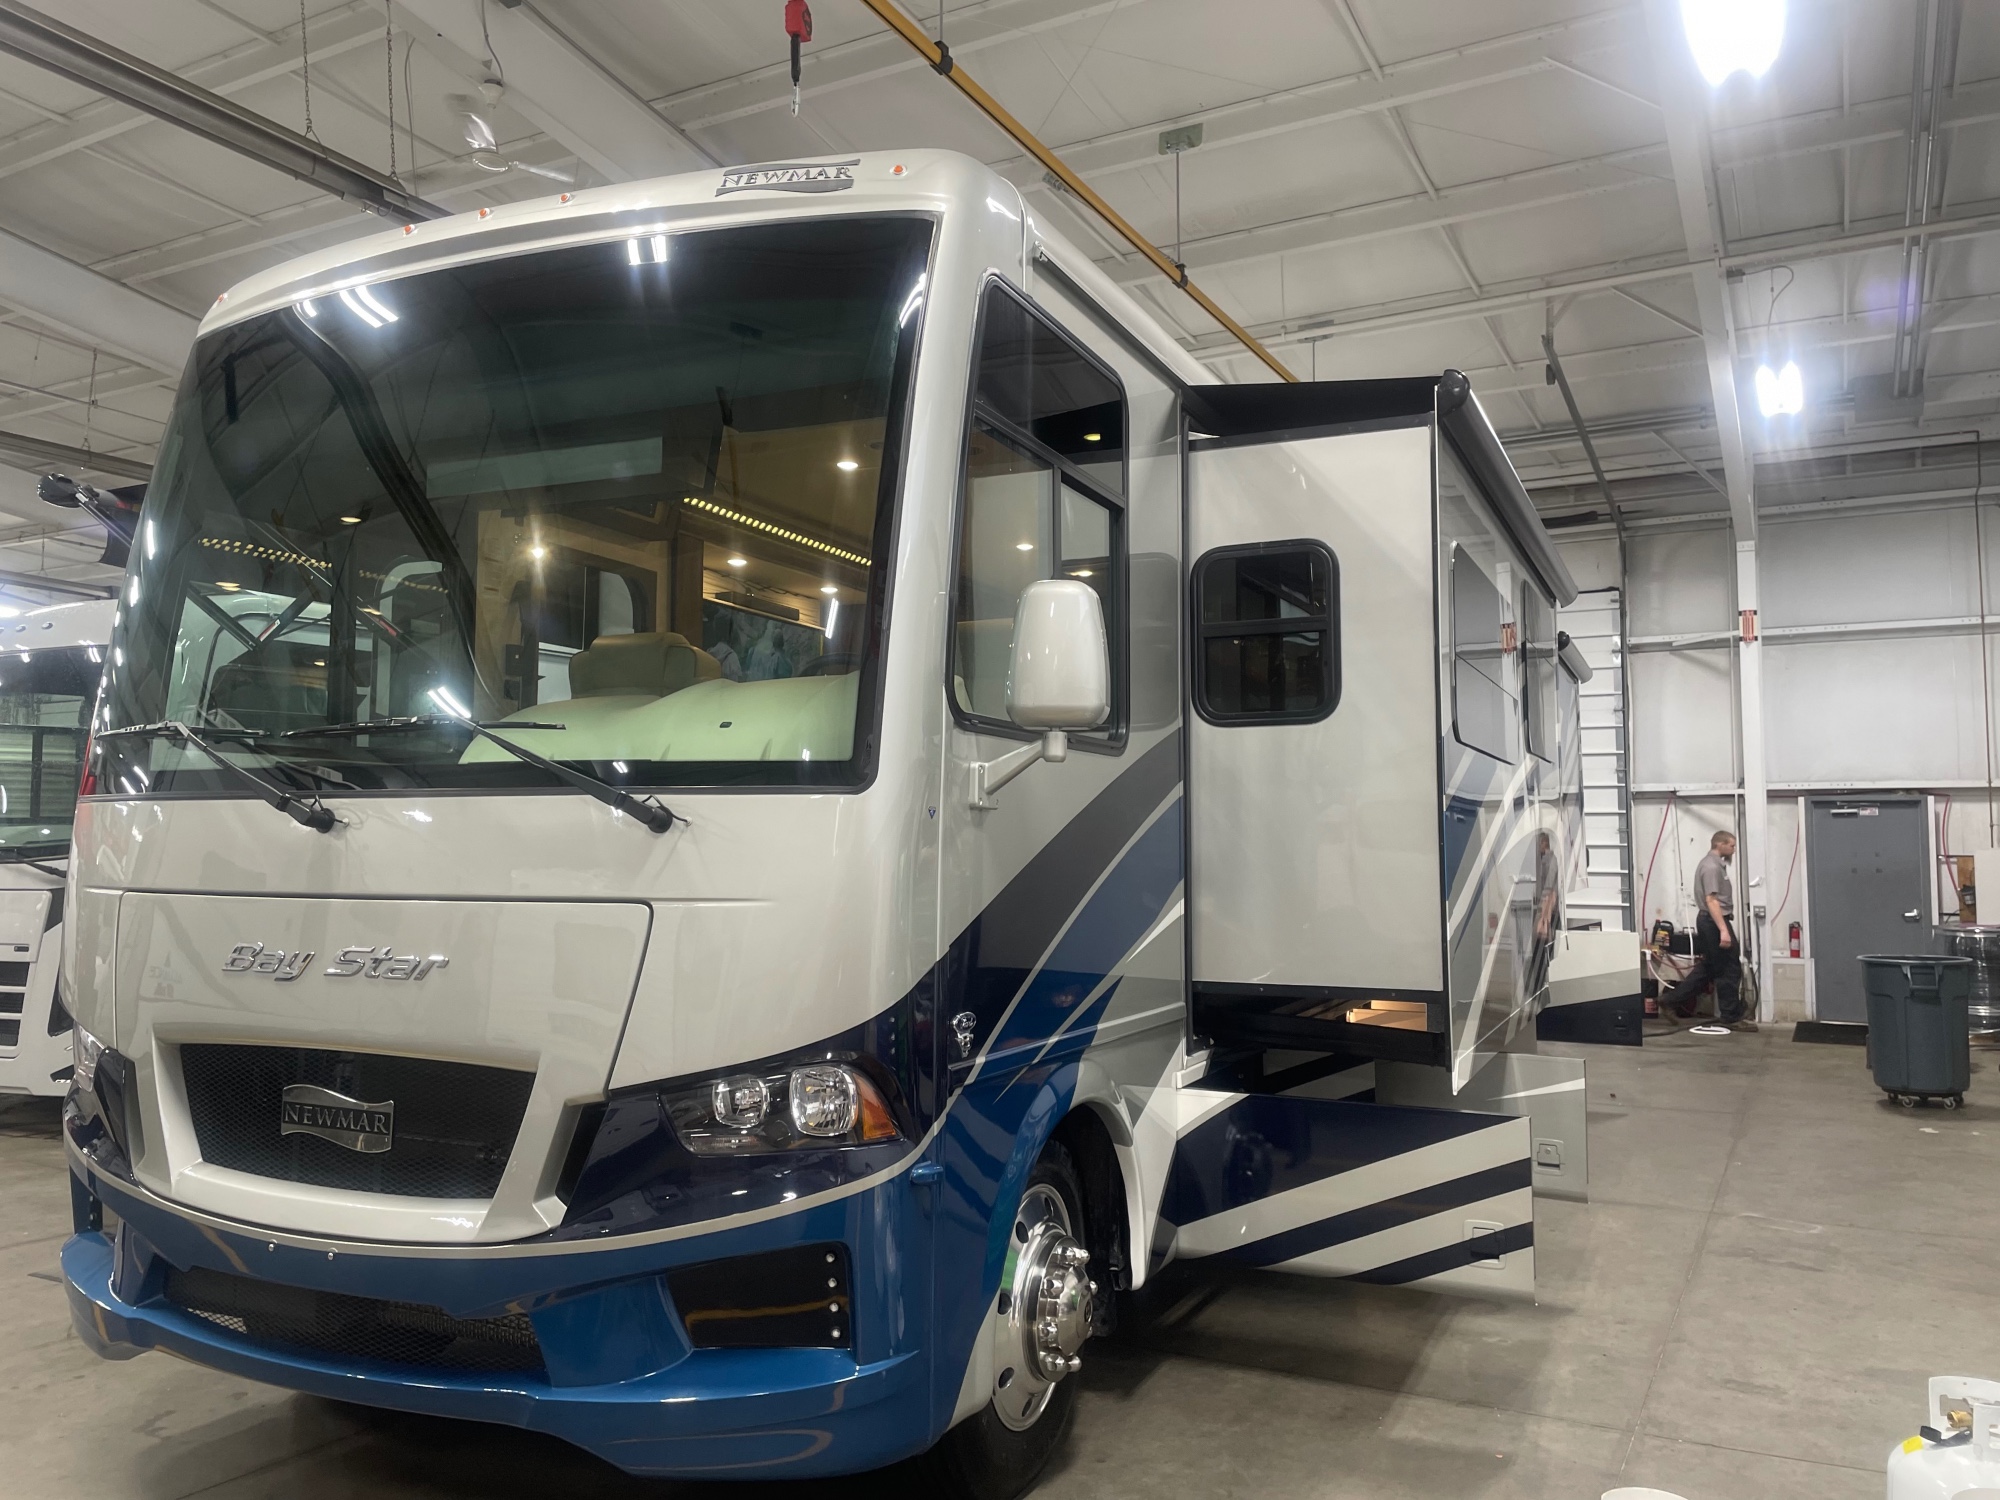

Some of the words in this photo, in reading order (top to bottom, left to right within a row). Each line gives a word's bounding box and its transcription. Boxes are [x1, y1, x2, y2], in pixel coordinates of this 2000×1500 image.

[720, 166, 853, 187] NEWMAR
[221, 941, 315, 982] Bay
[323, 945, 449, 981] Star
[284, 1103, 389, 1134] NEWMAR
